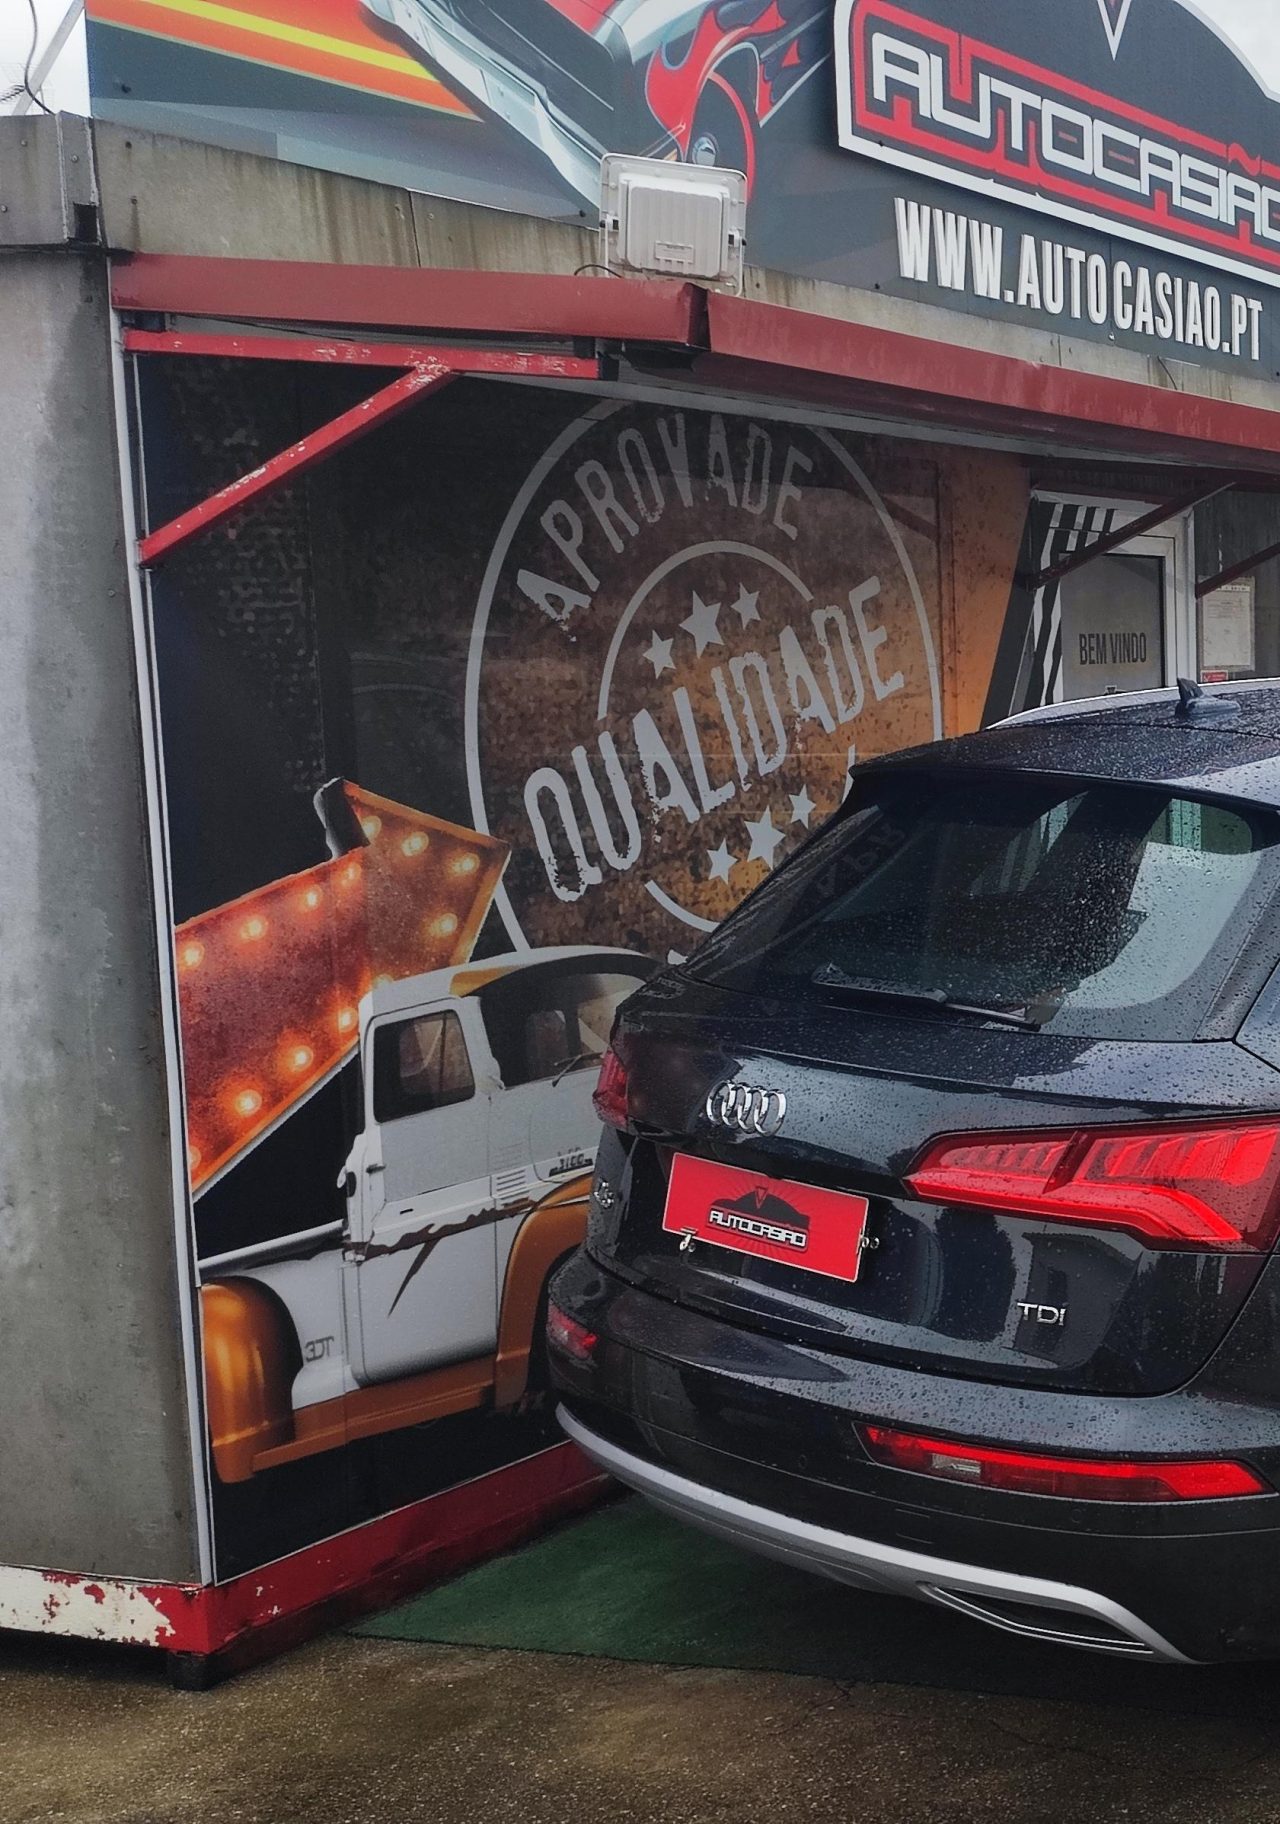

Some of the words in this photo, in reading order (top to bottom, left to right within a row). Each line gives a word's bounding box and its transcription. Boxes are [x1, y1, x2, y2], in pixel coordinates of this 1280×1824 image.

[894, 196, 1263, 361] WWW.AUTOCASIAO.PT
[1079, 633, 1107, 665] BEM
[1110, 632, 1147, 664] VINDO
[523, 575, 905, 902] QUALIDADE
[1017, 1302, 1067, 1326] TDI
